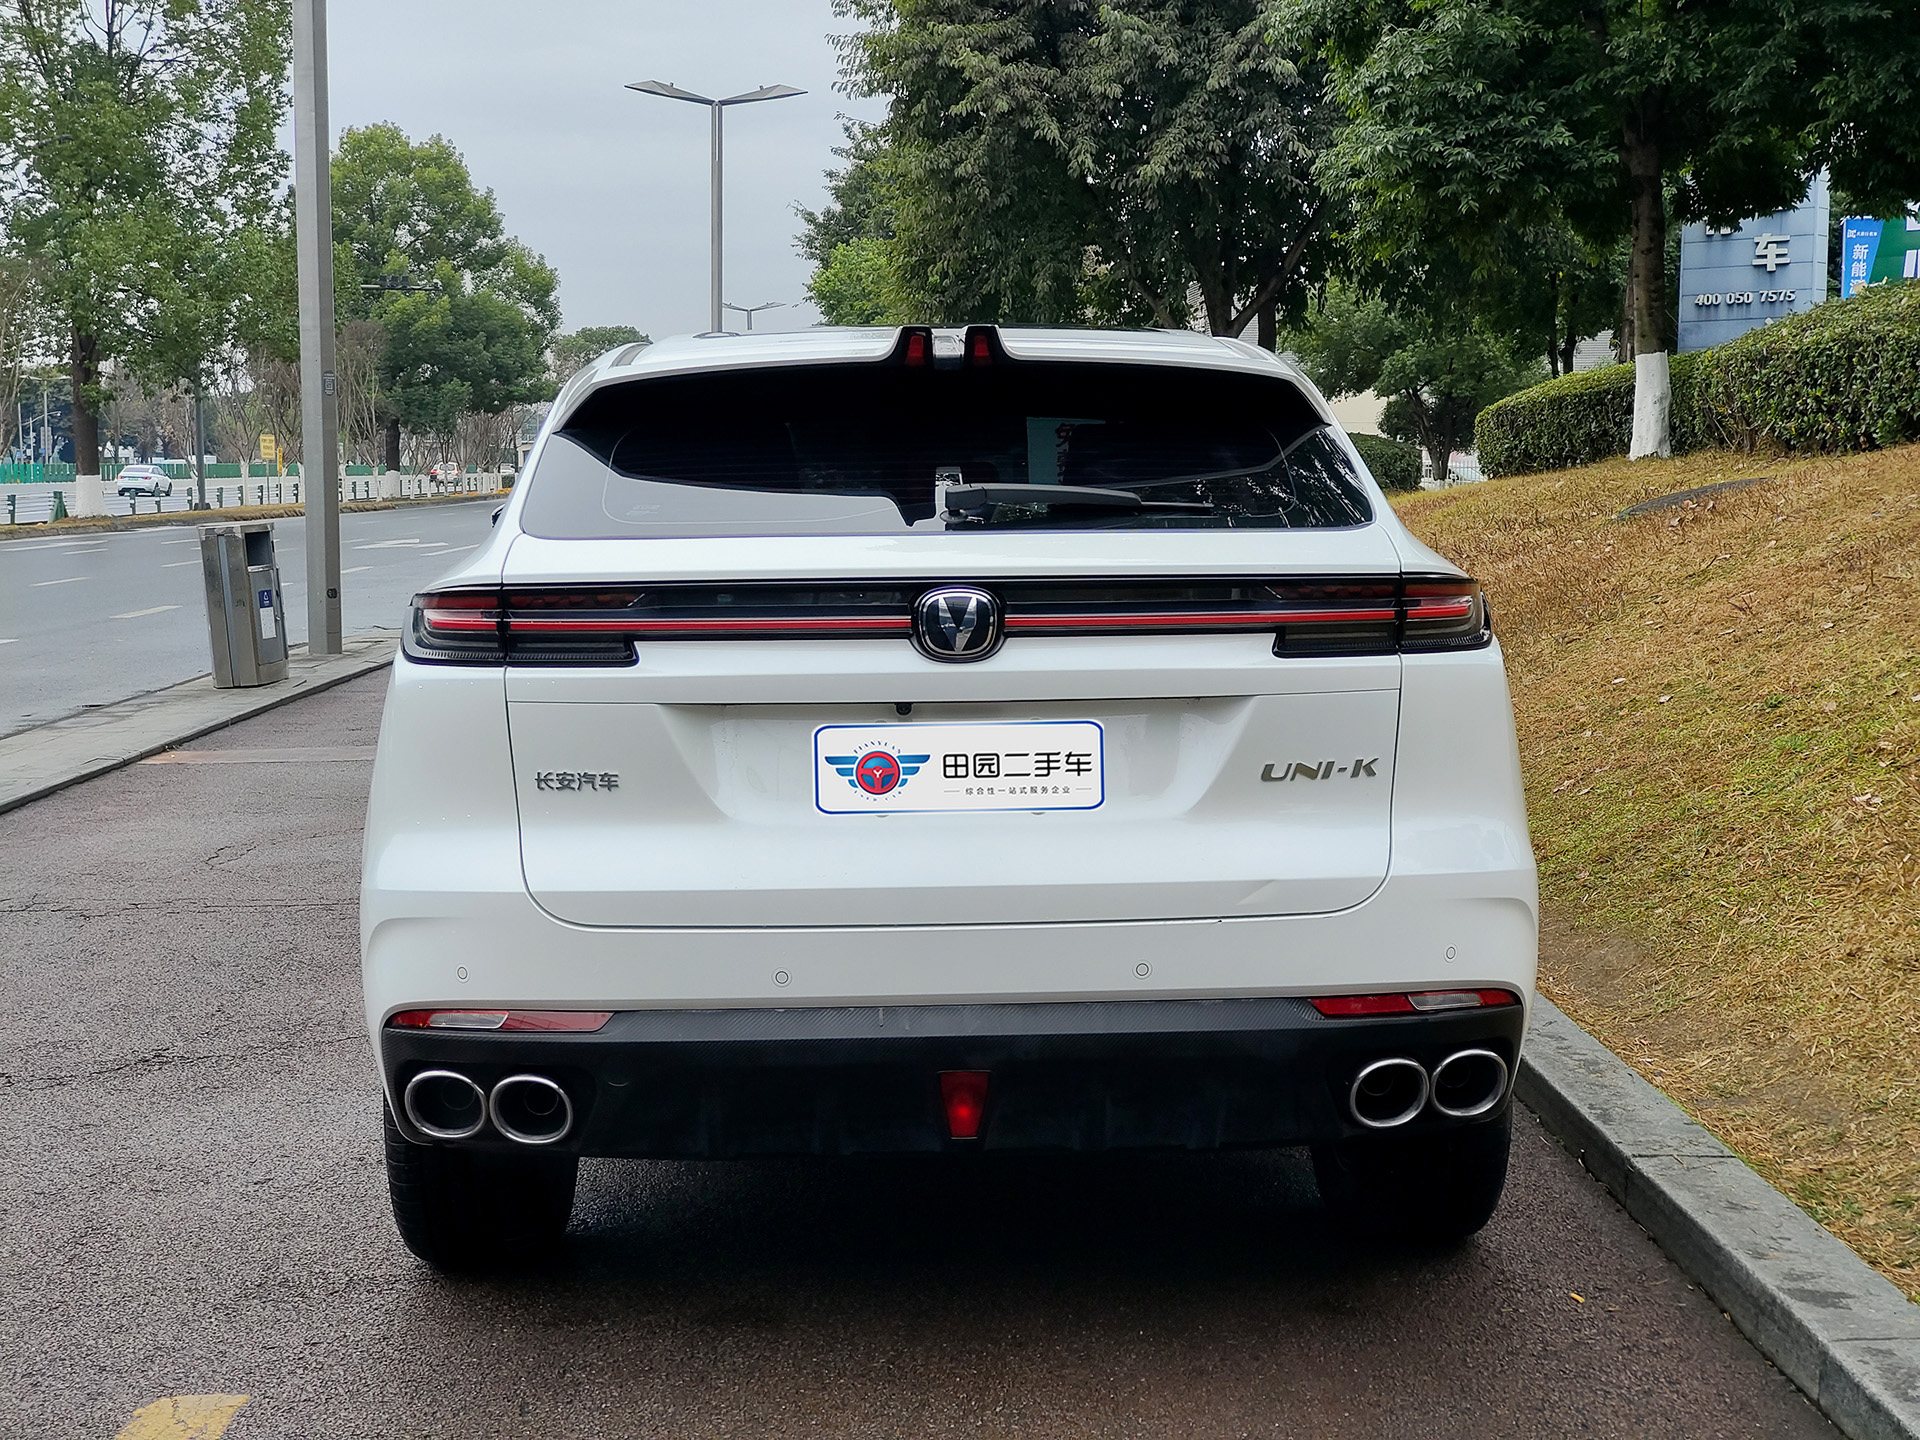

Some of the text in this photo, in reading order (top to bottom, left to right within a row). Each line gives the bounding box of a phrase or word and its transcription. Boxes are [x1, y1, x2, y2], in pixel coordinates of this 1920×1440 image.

[1752, 233, 1791, 272] 车
[1694, 289, 1796, 306] 400 050 7575
[943, 752, 1093, 779] 田园二手车
[1261, 757, 1379, 782] UNI-K
[534, 771, 619, 792] 长安汽车
[965, 785, 1071, 796] 综合性一站式服务企业
